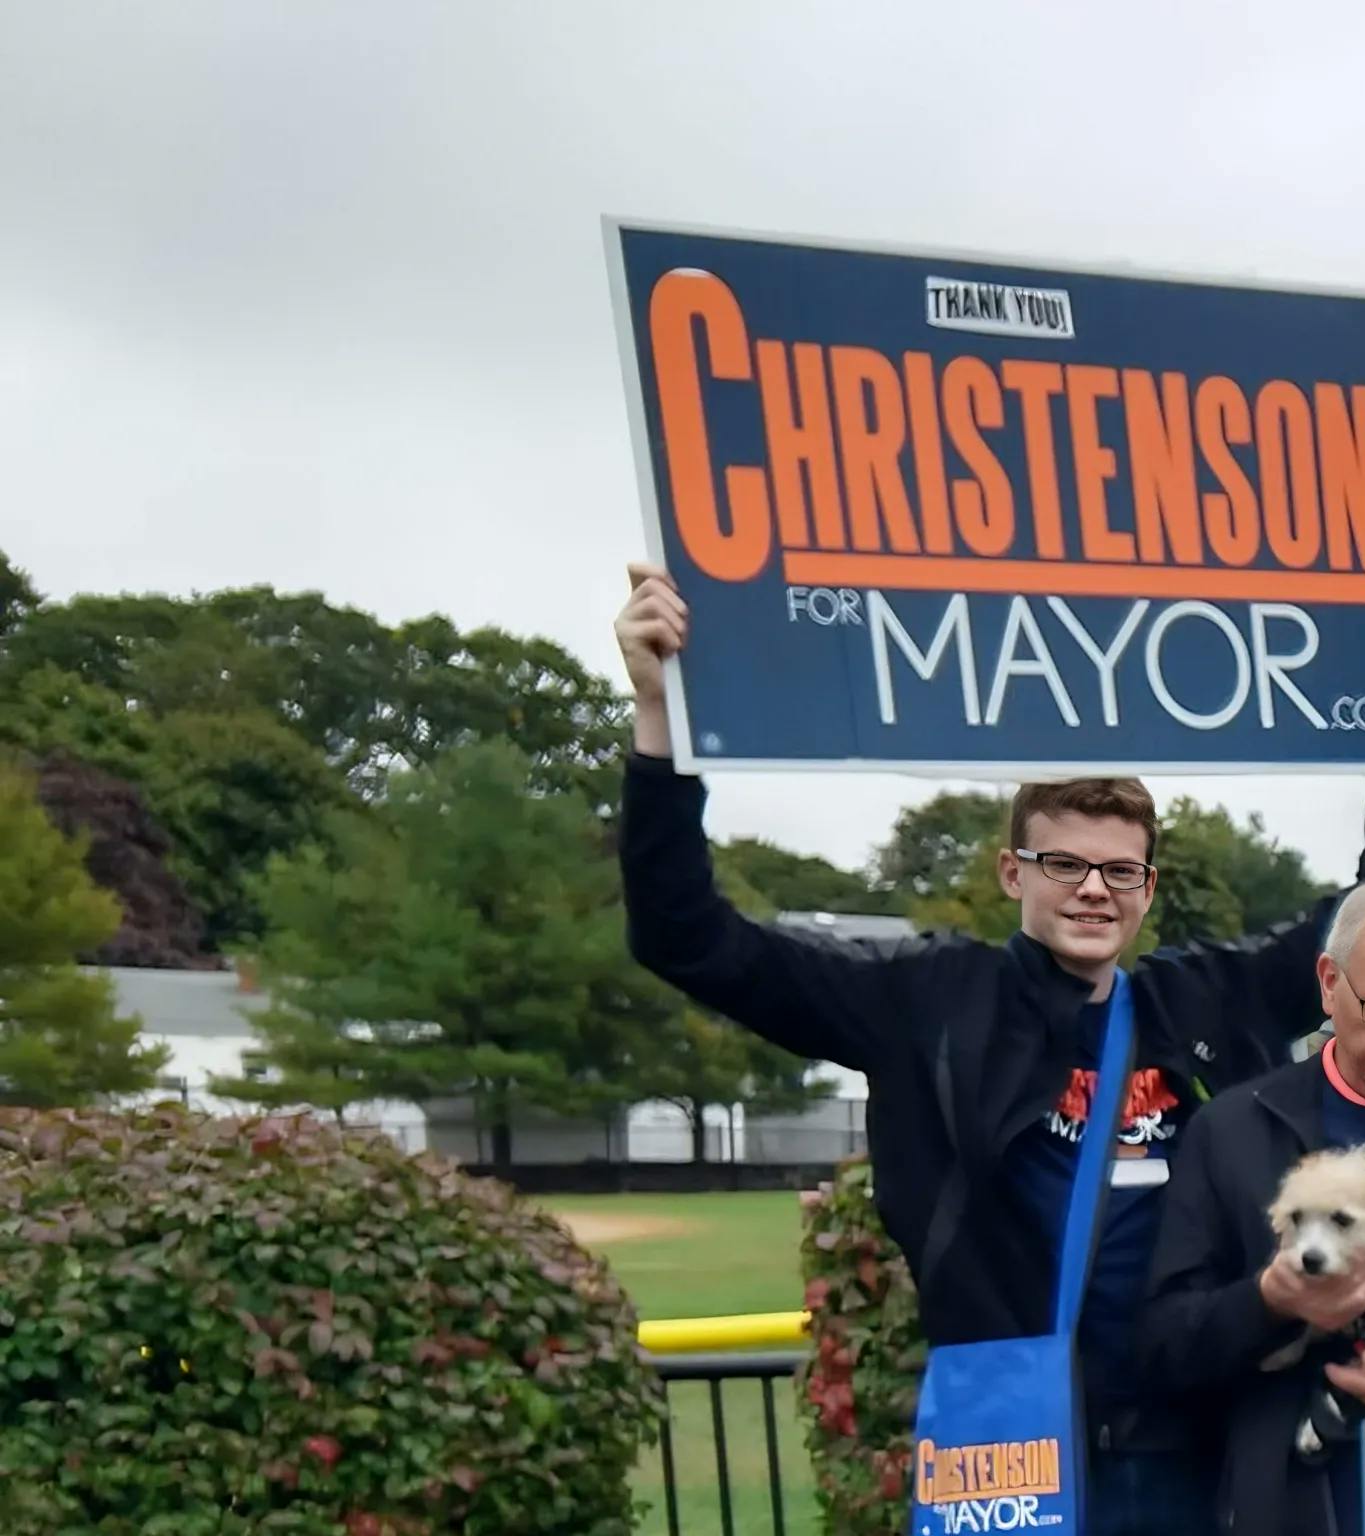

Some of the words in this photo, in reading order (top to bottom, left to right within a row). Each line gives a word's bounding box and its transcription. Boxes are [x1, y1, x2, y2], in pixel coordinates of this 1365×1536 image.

[929, 286, 1007, 323] THANK
[787, 586, 861, 626] FOR
[918, 1438, 1058, 1505] CSTENSON
